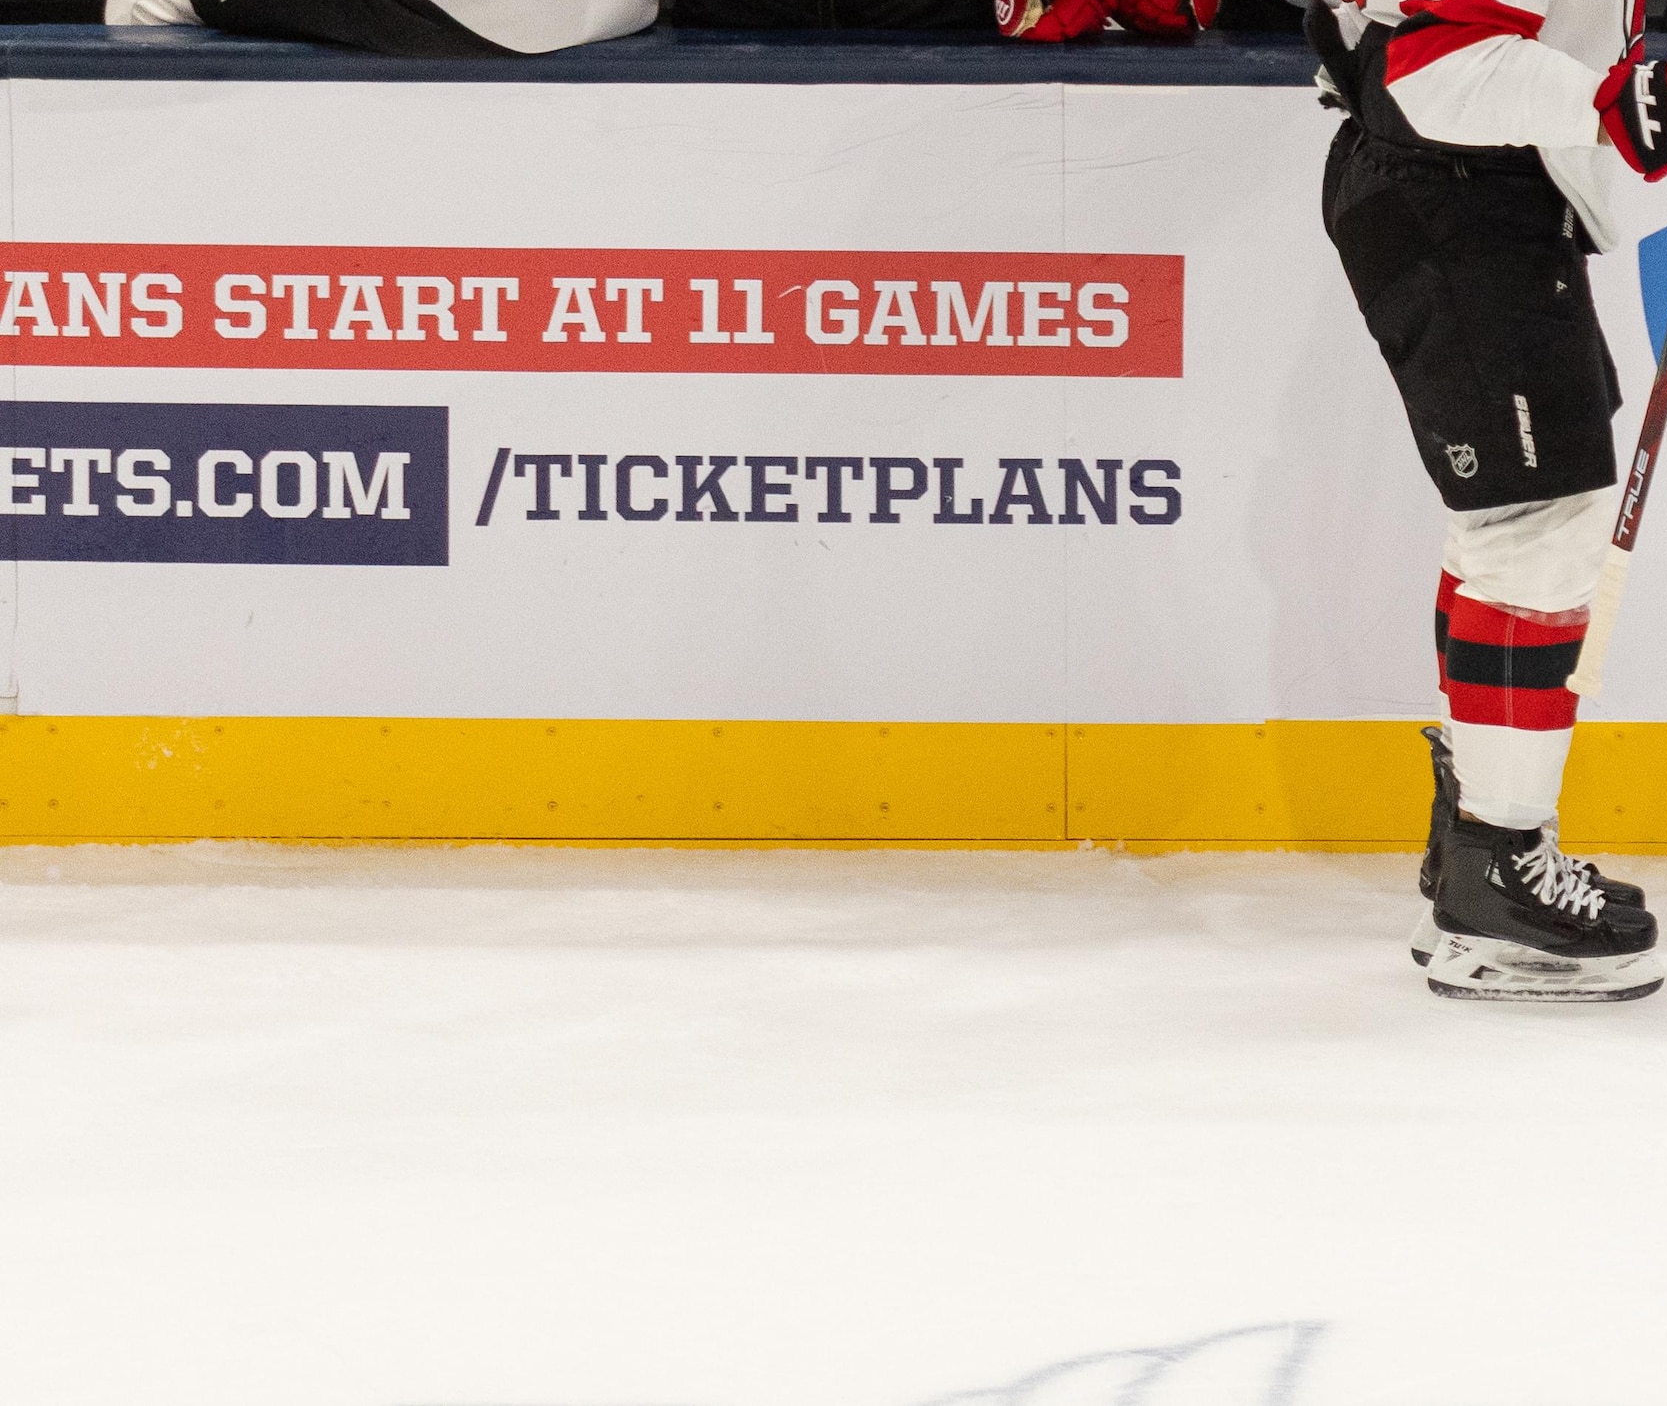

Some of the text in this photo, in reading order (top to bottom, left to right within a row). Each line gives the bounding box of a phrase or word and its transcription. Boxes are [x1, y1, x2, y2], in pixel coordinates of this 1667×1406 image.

[213, 275, 522, 343] START
[542, 278, 665, 344] AT
[689, 280, 774, 346] 11
[804, 281, 1131, 349] GAMES
[1512, 393, 1539, 469] BAUER
[475, 447, 1185, 528] /TICKETPLANS
[1616, 448, 1650, 542] TRUE
